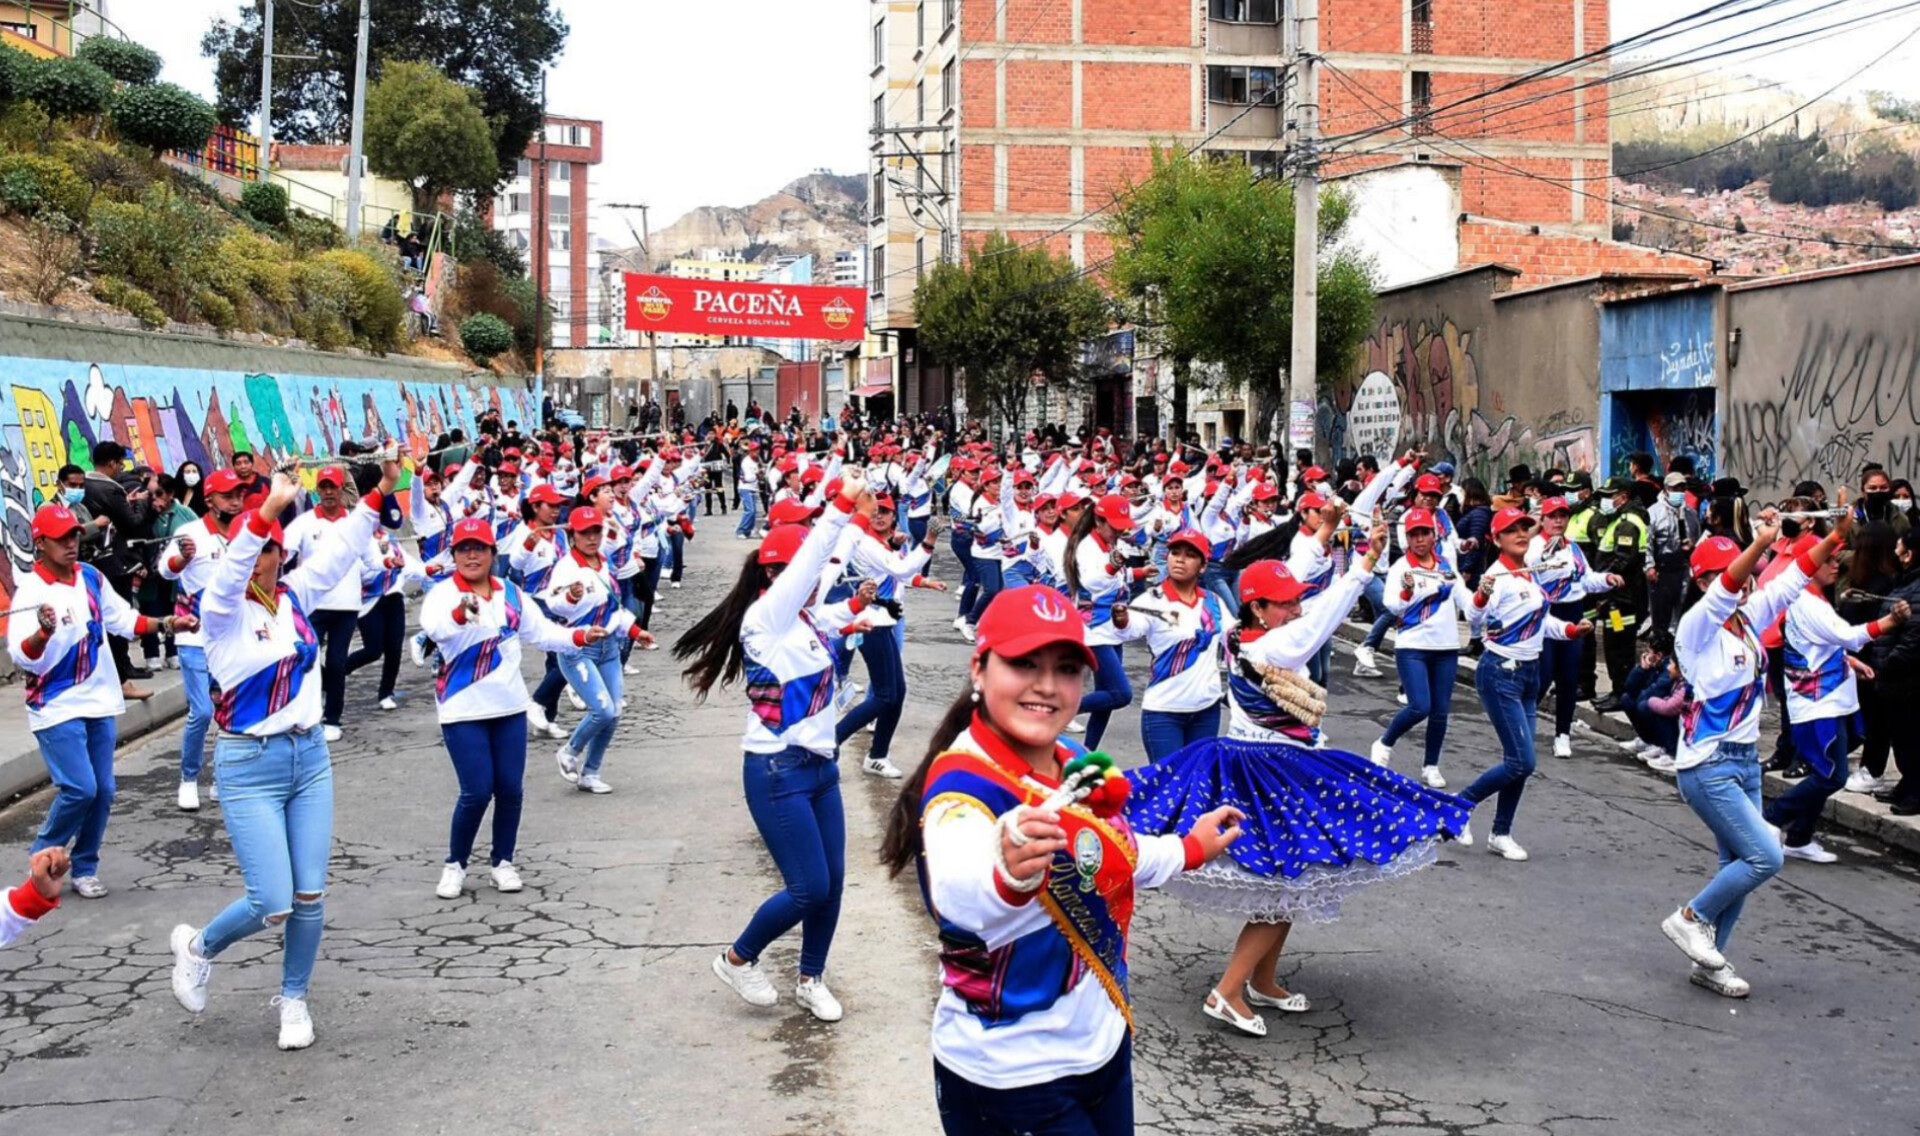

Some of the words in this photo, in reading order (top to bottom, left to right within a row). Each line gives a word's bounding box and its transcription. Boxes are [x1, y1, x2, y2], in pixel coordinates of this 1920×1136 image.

[693, 288, 804, 316] PACEÑA
[707, 316, 744, 324] CERVEZA
[747, 318, 791, 327] BOLIVIANA
